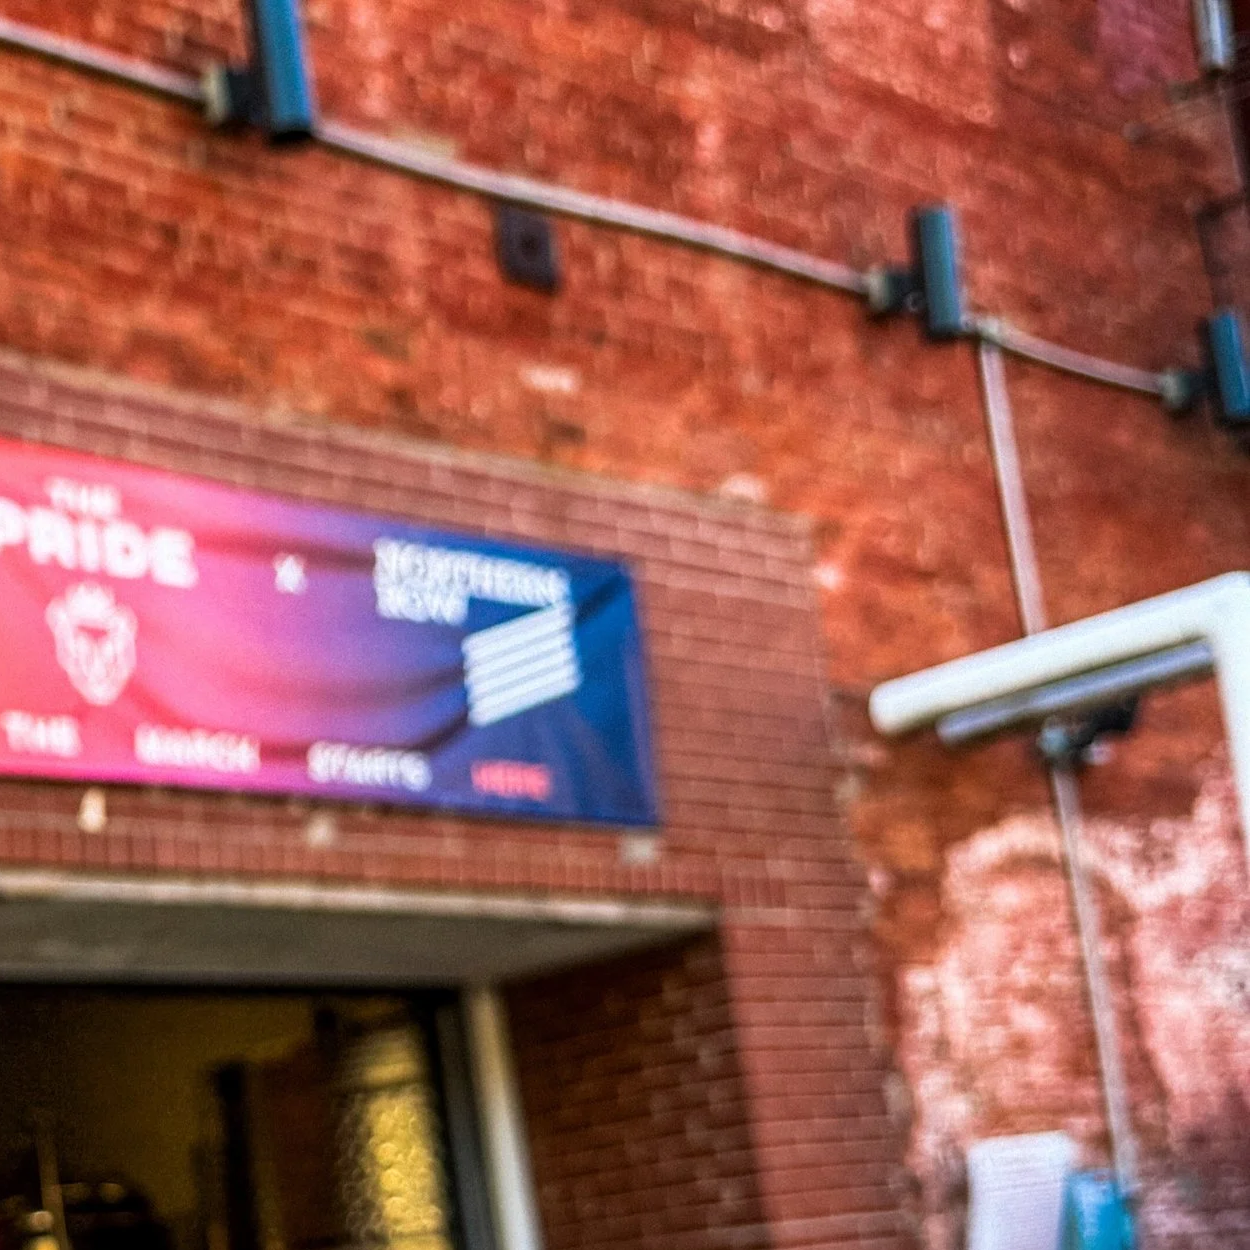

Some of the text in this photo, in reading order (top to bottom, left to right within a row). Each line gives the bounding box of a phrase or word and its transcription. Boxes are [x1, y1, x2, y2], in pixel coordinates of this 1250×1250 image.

[46, 477, 121, 519] THE
[373, 537, 572, 609] NORTHERN
[375, 582, 469, 626] ROW
[0, 708, 82, 757] THE
